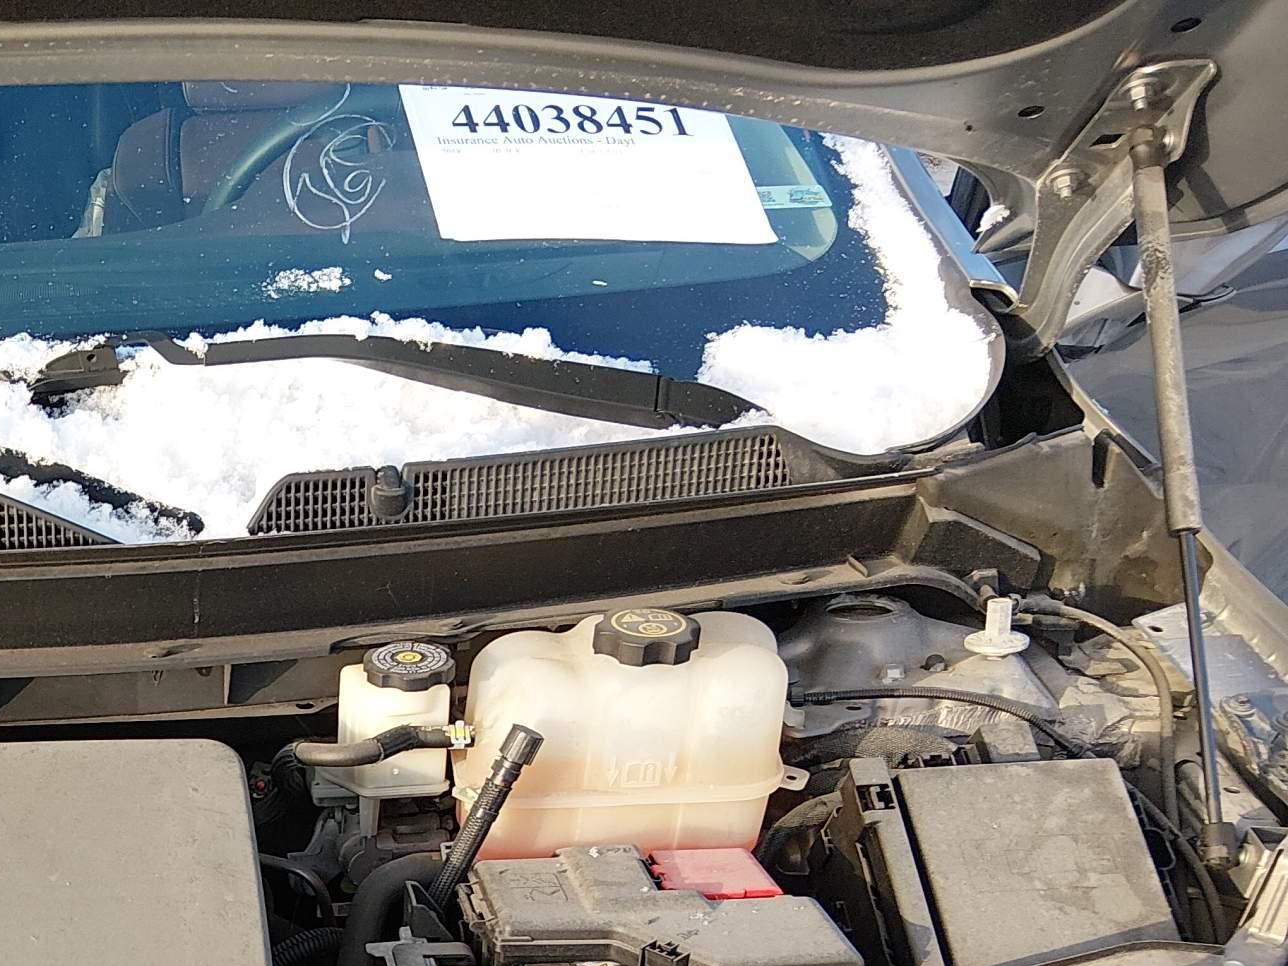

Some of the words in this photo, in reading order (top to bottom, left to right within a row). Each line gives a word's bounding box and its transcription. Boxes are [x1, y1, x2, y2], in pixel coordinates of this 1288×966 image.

[452, 103, 694, 137] 44038451
[437, 135, 499, 145] Insurance
[503, 135, 534, 145] Auto
[538, 135, 594, 145] Auctions
